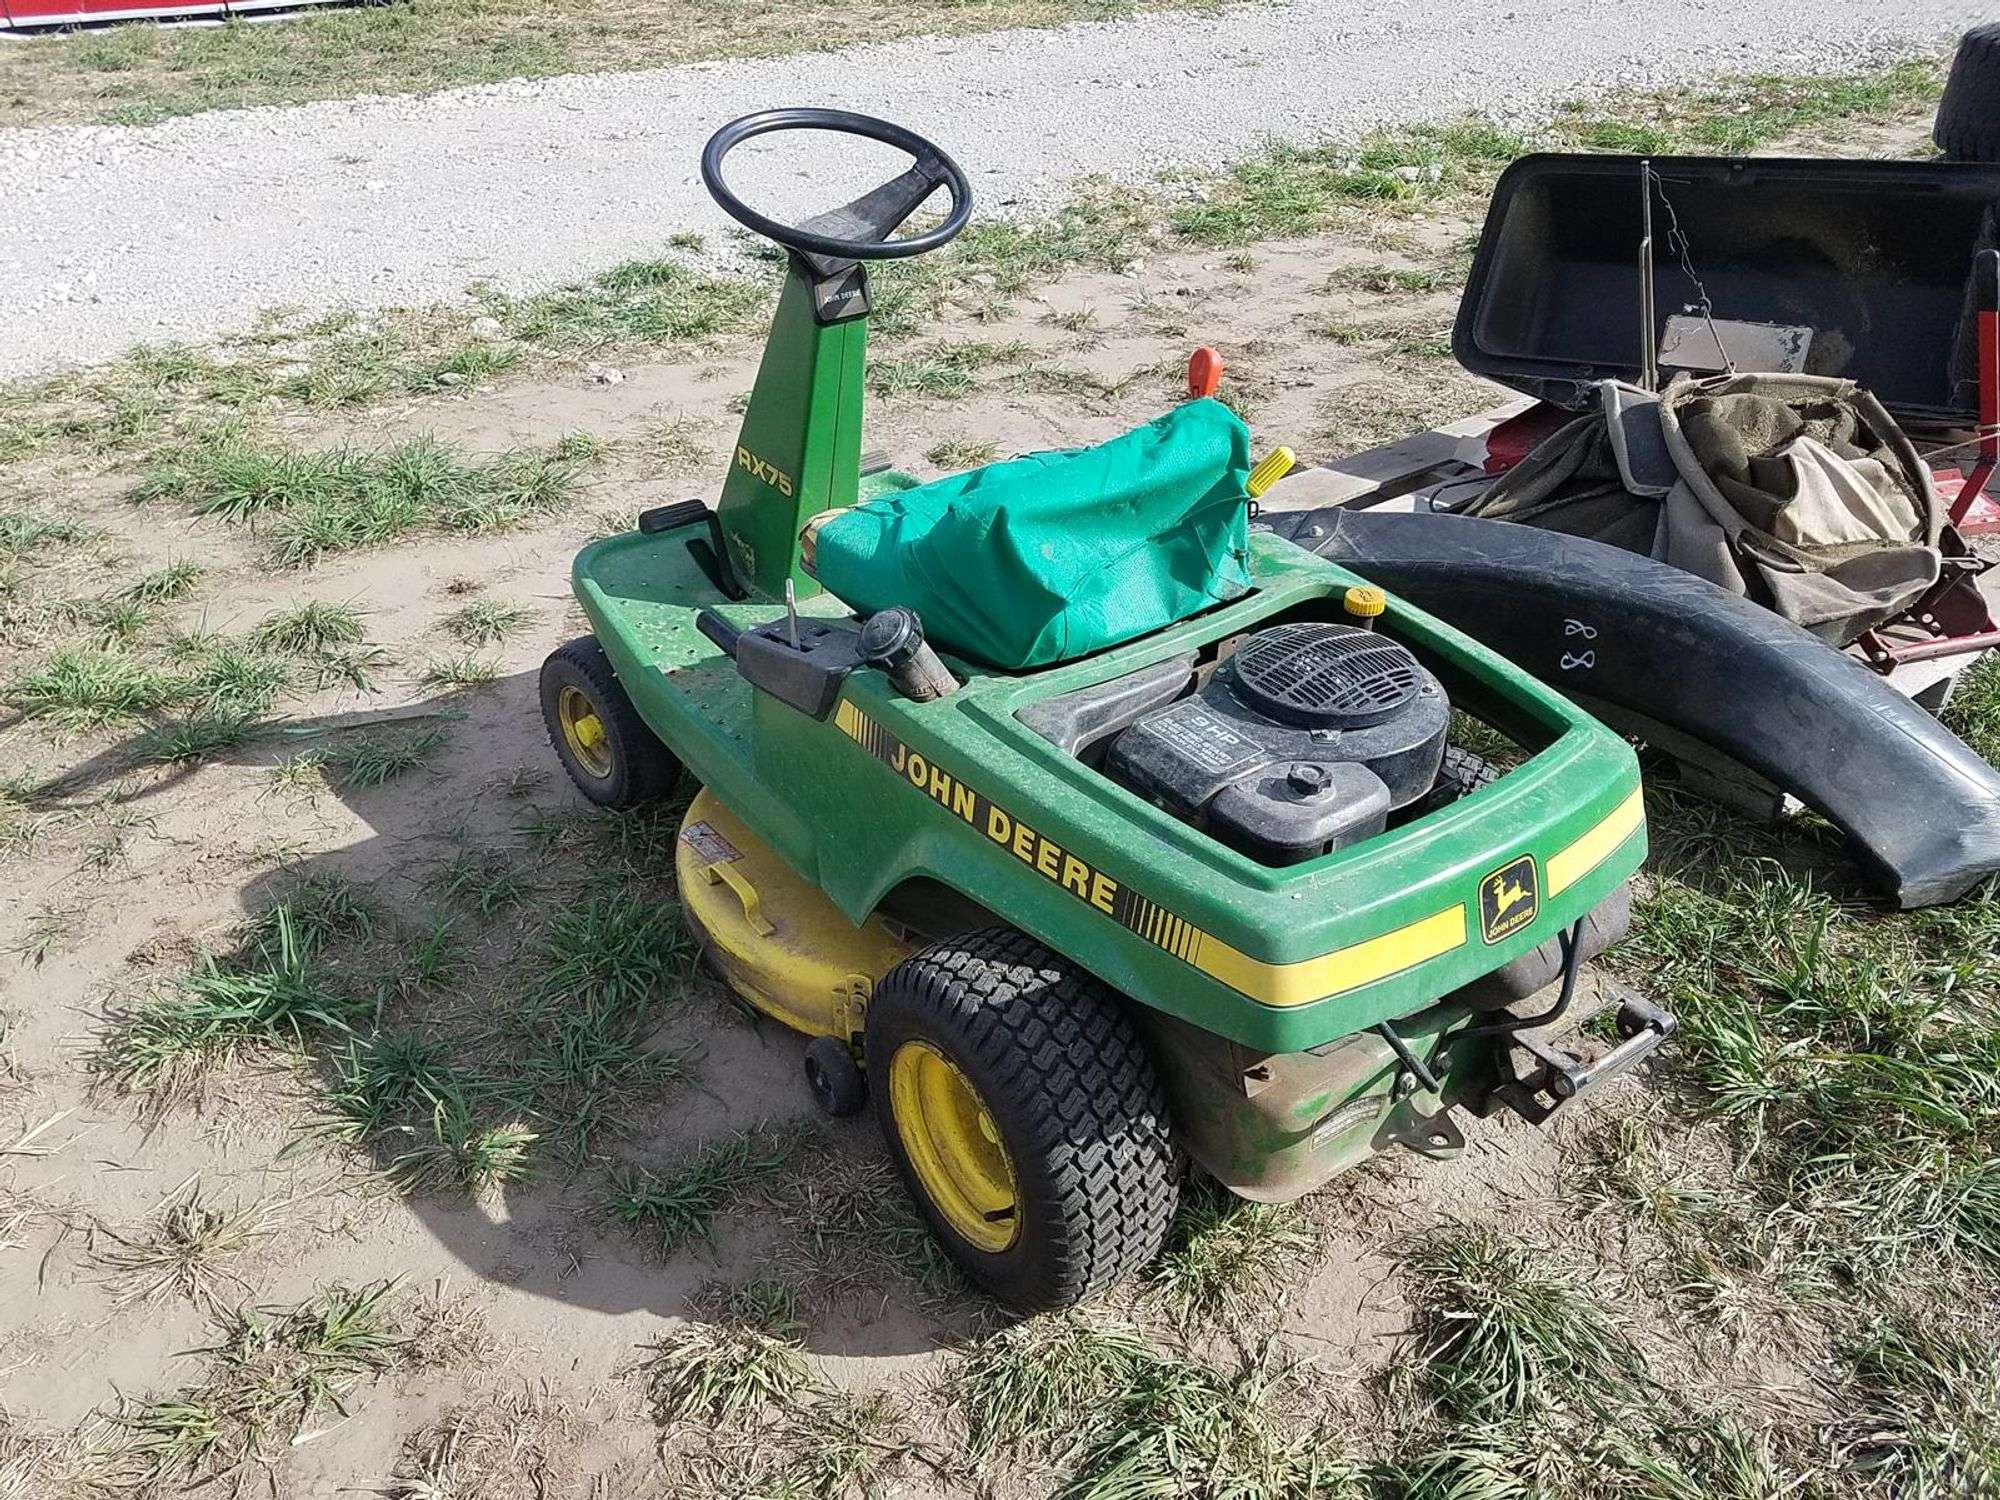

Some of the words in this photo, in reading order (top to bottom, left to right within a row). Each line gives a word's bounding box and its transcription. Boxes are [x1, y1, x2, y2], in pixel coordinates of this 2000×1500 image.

[737, 445, 793, 497] RX75
[1560, 618, 1598, 670] 88
[890, 743, 976, 824] JOHN
[987, 804, 1118, 915] DEERE
[1488, 920, 1509, 938] JOHN
[1509, 906, 1534, 927] DEERE
